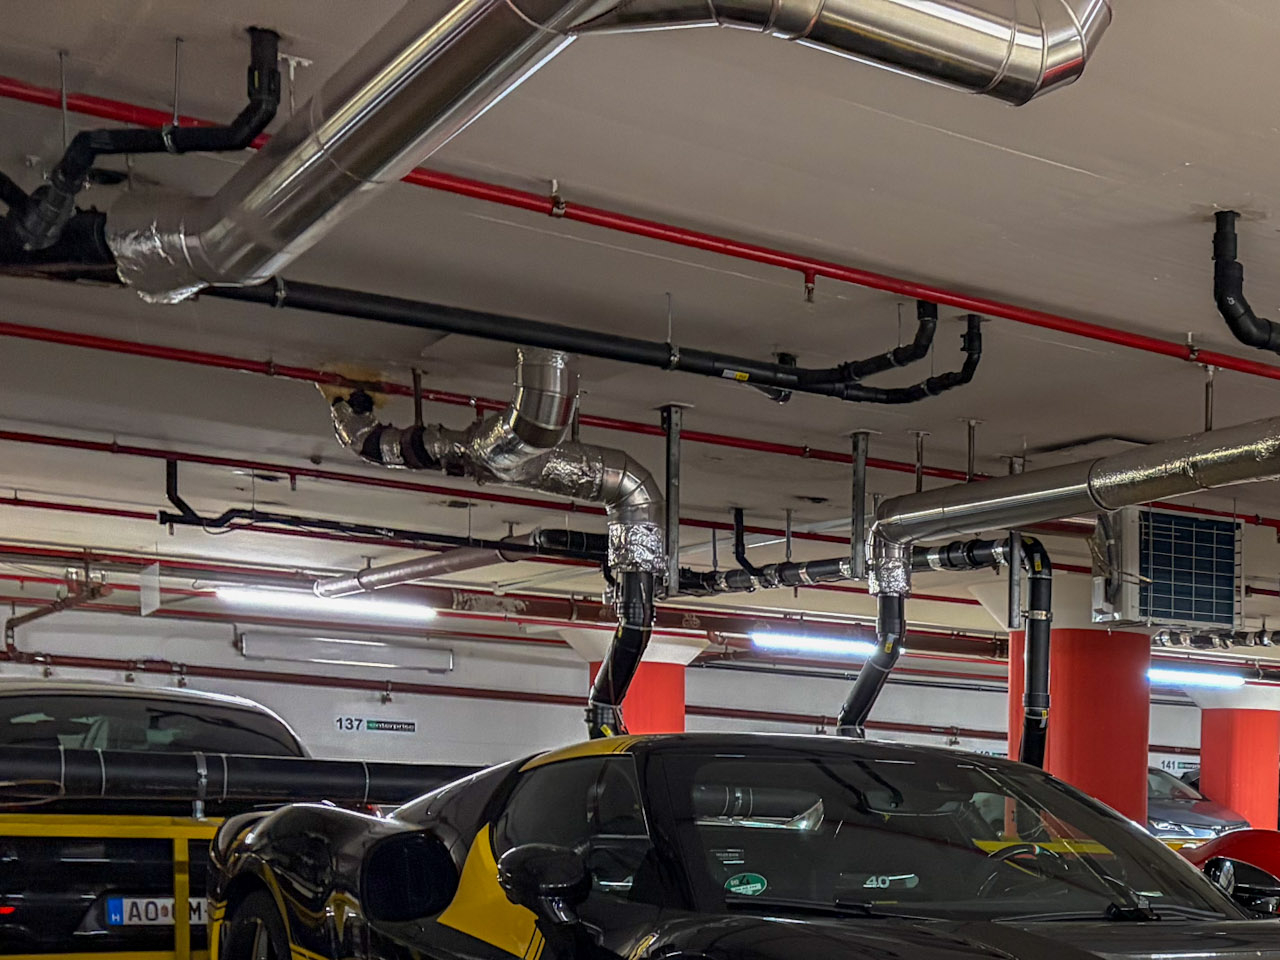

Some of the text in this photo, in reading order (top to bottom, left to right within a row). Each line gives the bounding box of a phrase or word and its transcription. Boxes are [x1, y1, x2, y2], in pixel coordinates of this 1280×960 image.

[336, 717, 363, 731] 137
[1161, 760, 1176, 770] 141
[128, 901, 159, 921] AO
